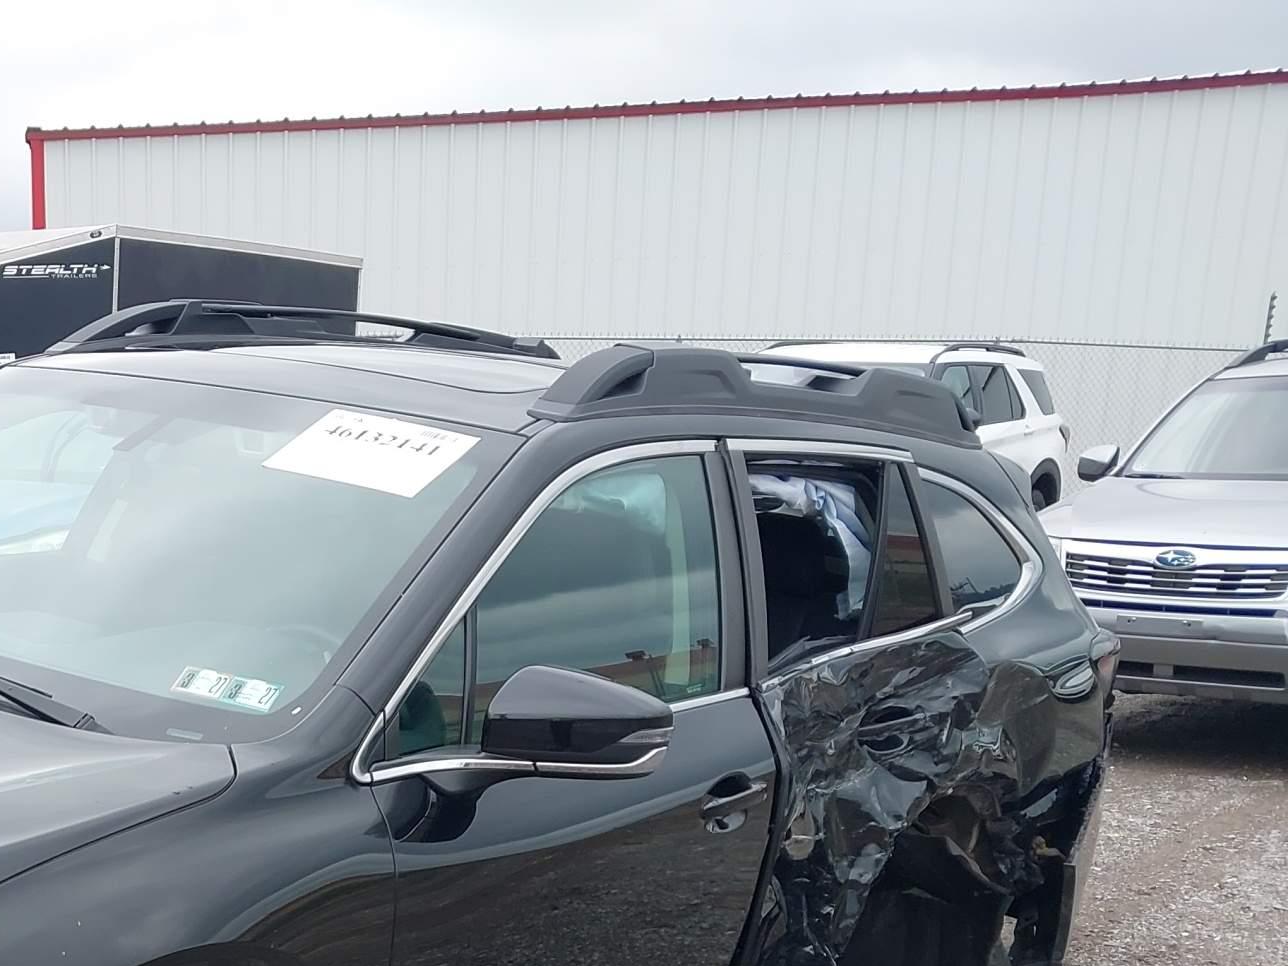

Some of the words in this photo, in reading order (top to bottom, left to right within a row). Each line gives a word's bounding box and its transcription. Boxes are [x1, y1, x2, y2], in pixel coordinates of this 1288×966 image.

[3, 264, 98, 275] STEALTH
[324, 425, 440, 456] 46132141
[208, 676, 228, 695] 27
[228, 683, 242, 700] 3
[258, 687, 278, 705] 27
